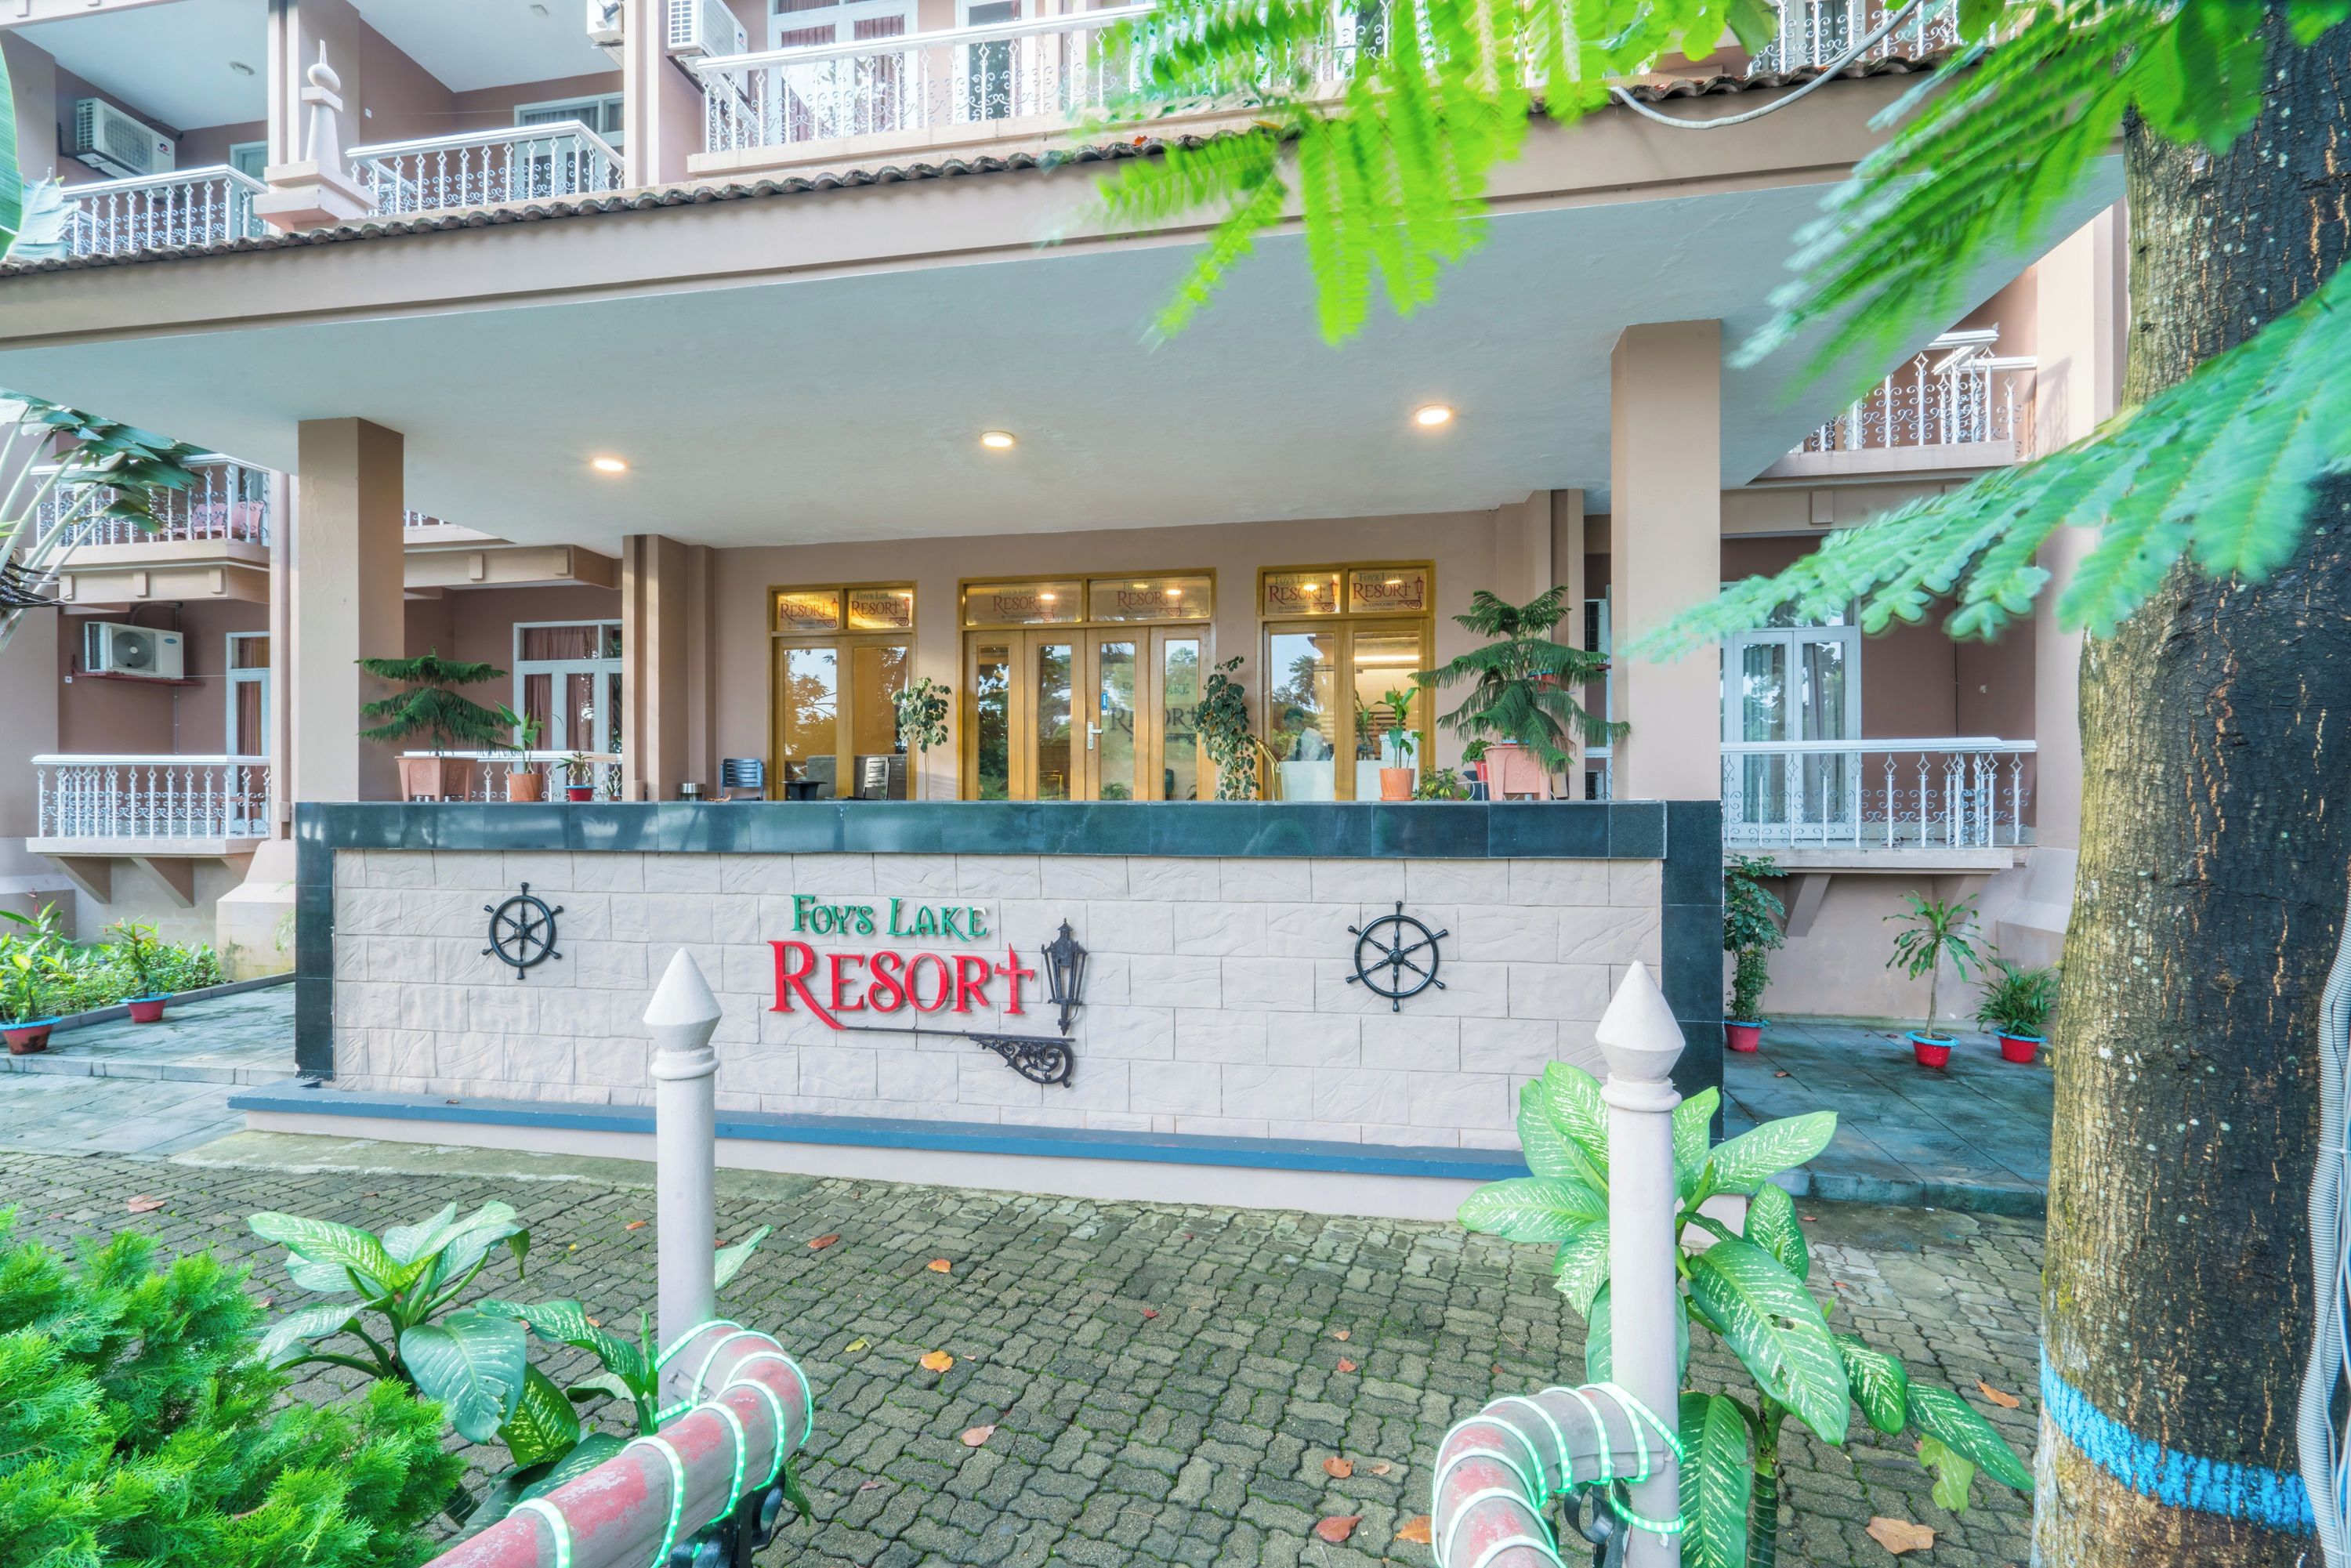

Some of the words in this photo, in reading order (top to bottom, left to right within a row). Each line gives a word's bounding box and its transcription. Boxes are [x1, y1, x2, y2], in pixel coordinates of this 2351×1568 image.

[1352, 581, 1411, 602] RESORT
[781, 603, 828, 621] RESORT
[851, 599, 900, 618] RESORT
[790, 894, 875, 935] FOY'S
[886, 897, 987, 942] LAKE
[768, 940, 1035, 1030] RESORT
